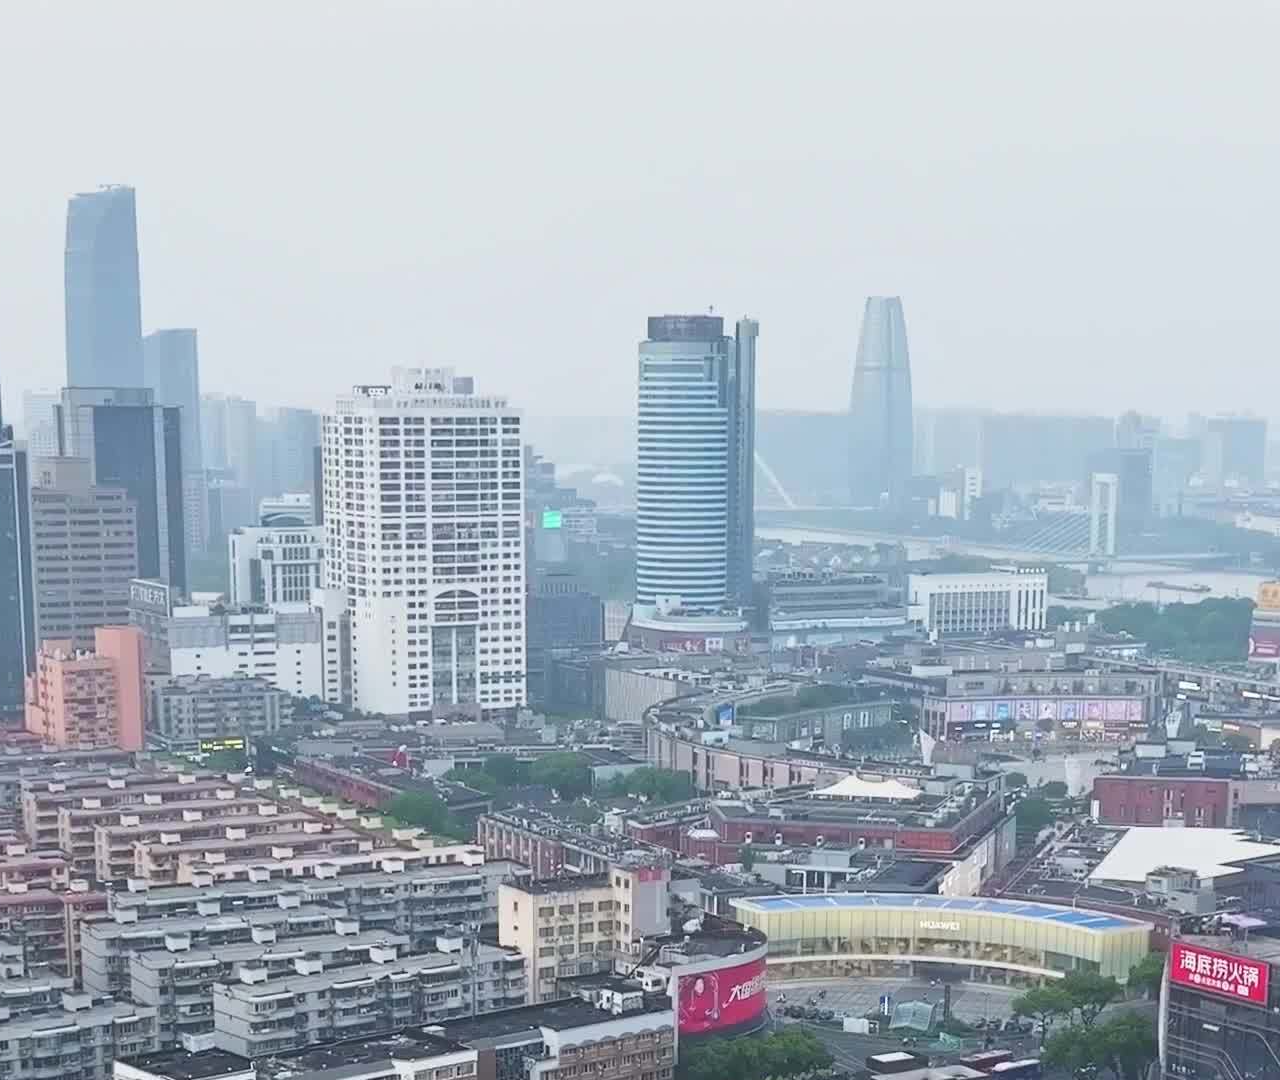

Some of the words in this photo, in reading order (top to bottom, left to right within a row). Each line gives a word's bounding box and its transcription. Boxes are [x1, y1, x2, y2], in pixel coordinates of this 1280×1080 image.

[920, 920, 960, 930] HUAWEI
[1180, 949, 1259, 988] 海底捞火锅
